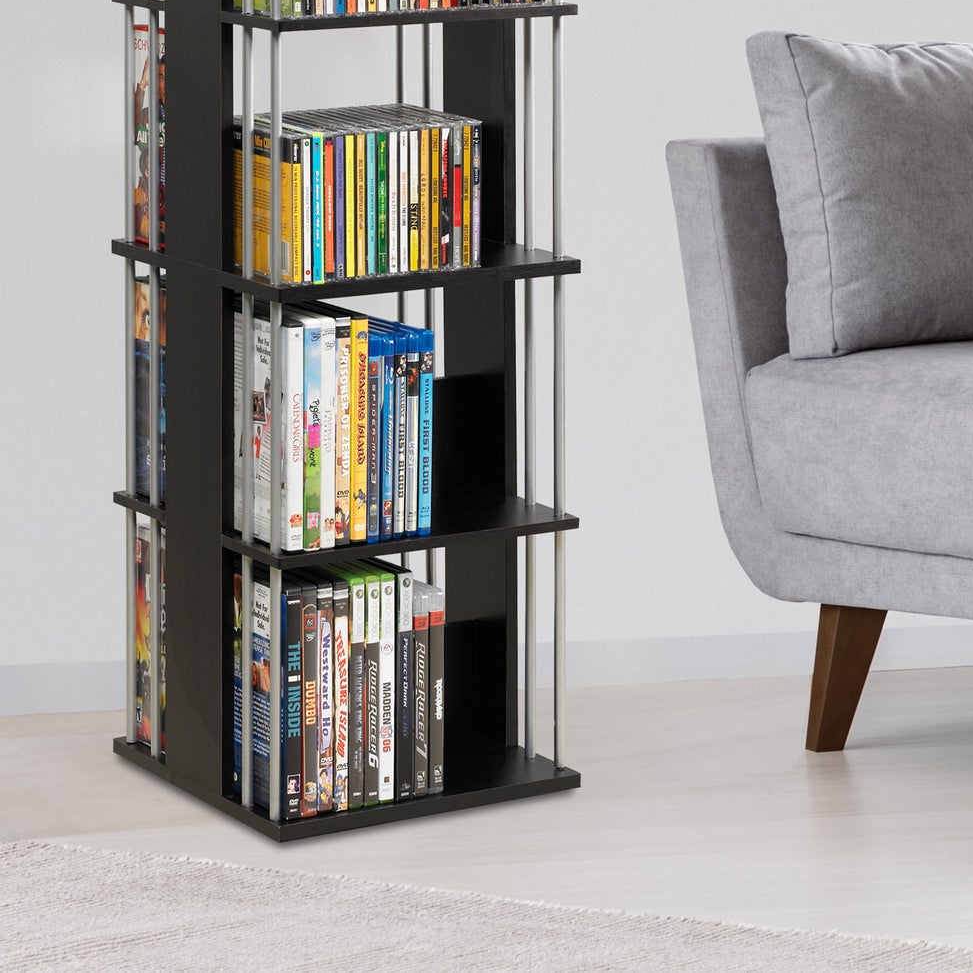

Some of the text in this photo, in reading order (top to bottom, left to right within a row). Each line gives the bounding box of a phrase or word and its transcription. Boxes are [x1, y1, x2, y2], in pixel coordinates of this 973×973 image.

[256, 344, 271, 356] Individua
[292, 393, 301, 463] CALENDAR GIRLS
[310, 399, 320, 427] Piglet's
[340, 346, 352, 478] PRISONER OF ZENDA
[356, 352, 366, 465] TREASURE ISLAND
[308, 425, 321, 448] BIG
[385, 415, 394, 475] Underdog
[370, 472, 376, 484] 3
[288, 641, 301, 672] THE
[305, 680, 316, 726] DUMBO
[322, 633, 330, 736] Westward Ho
[334, 630, 348, 759] TREASURE ISLAND
[288, 686, 301, 738] INSIDE
[382, 682, 392, 753] MADDEN 06
[368, 753, 378, 768] 6
[416, 743, 427, 760] 7
